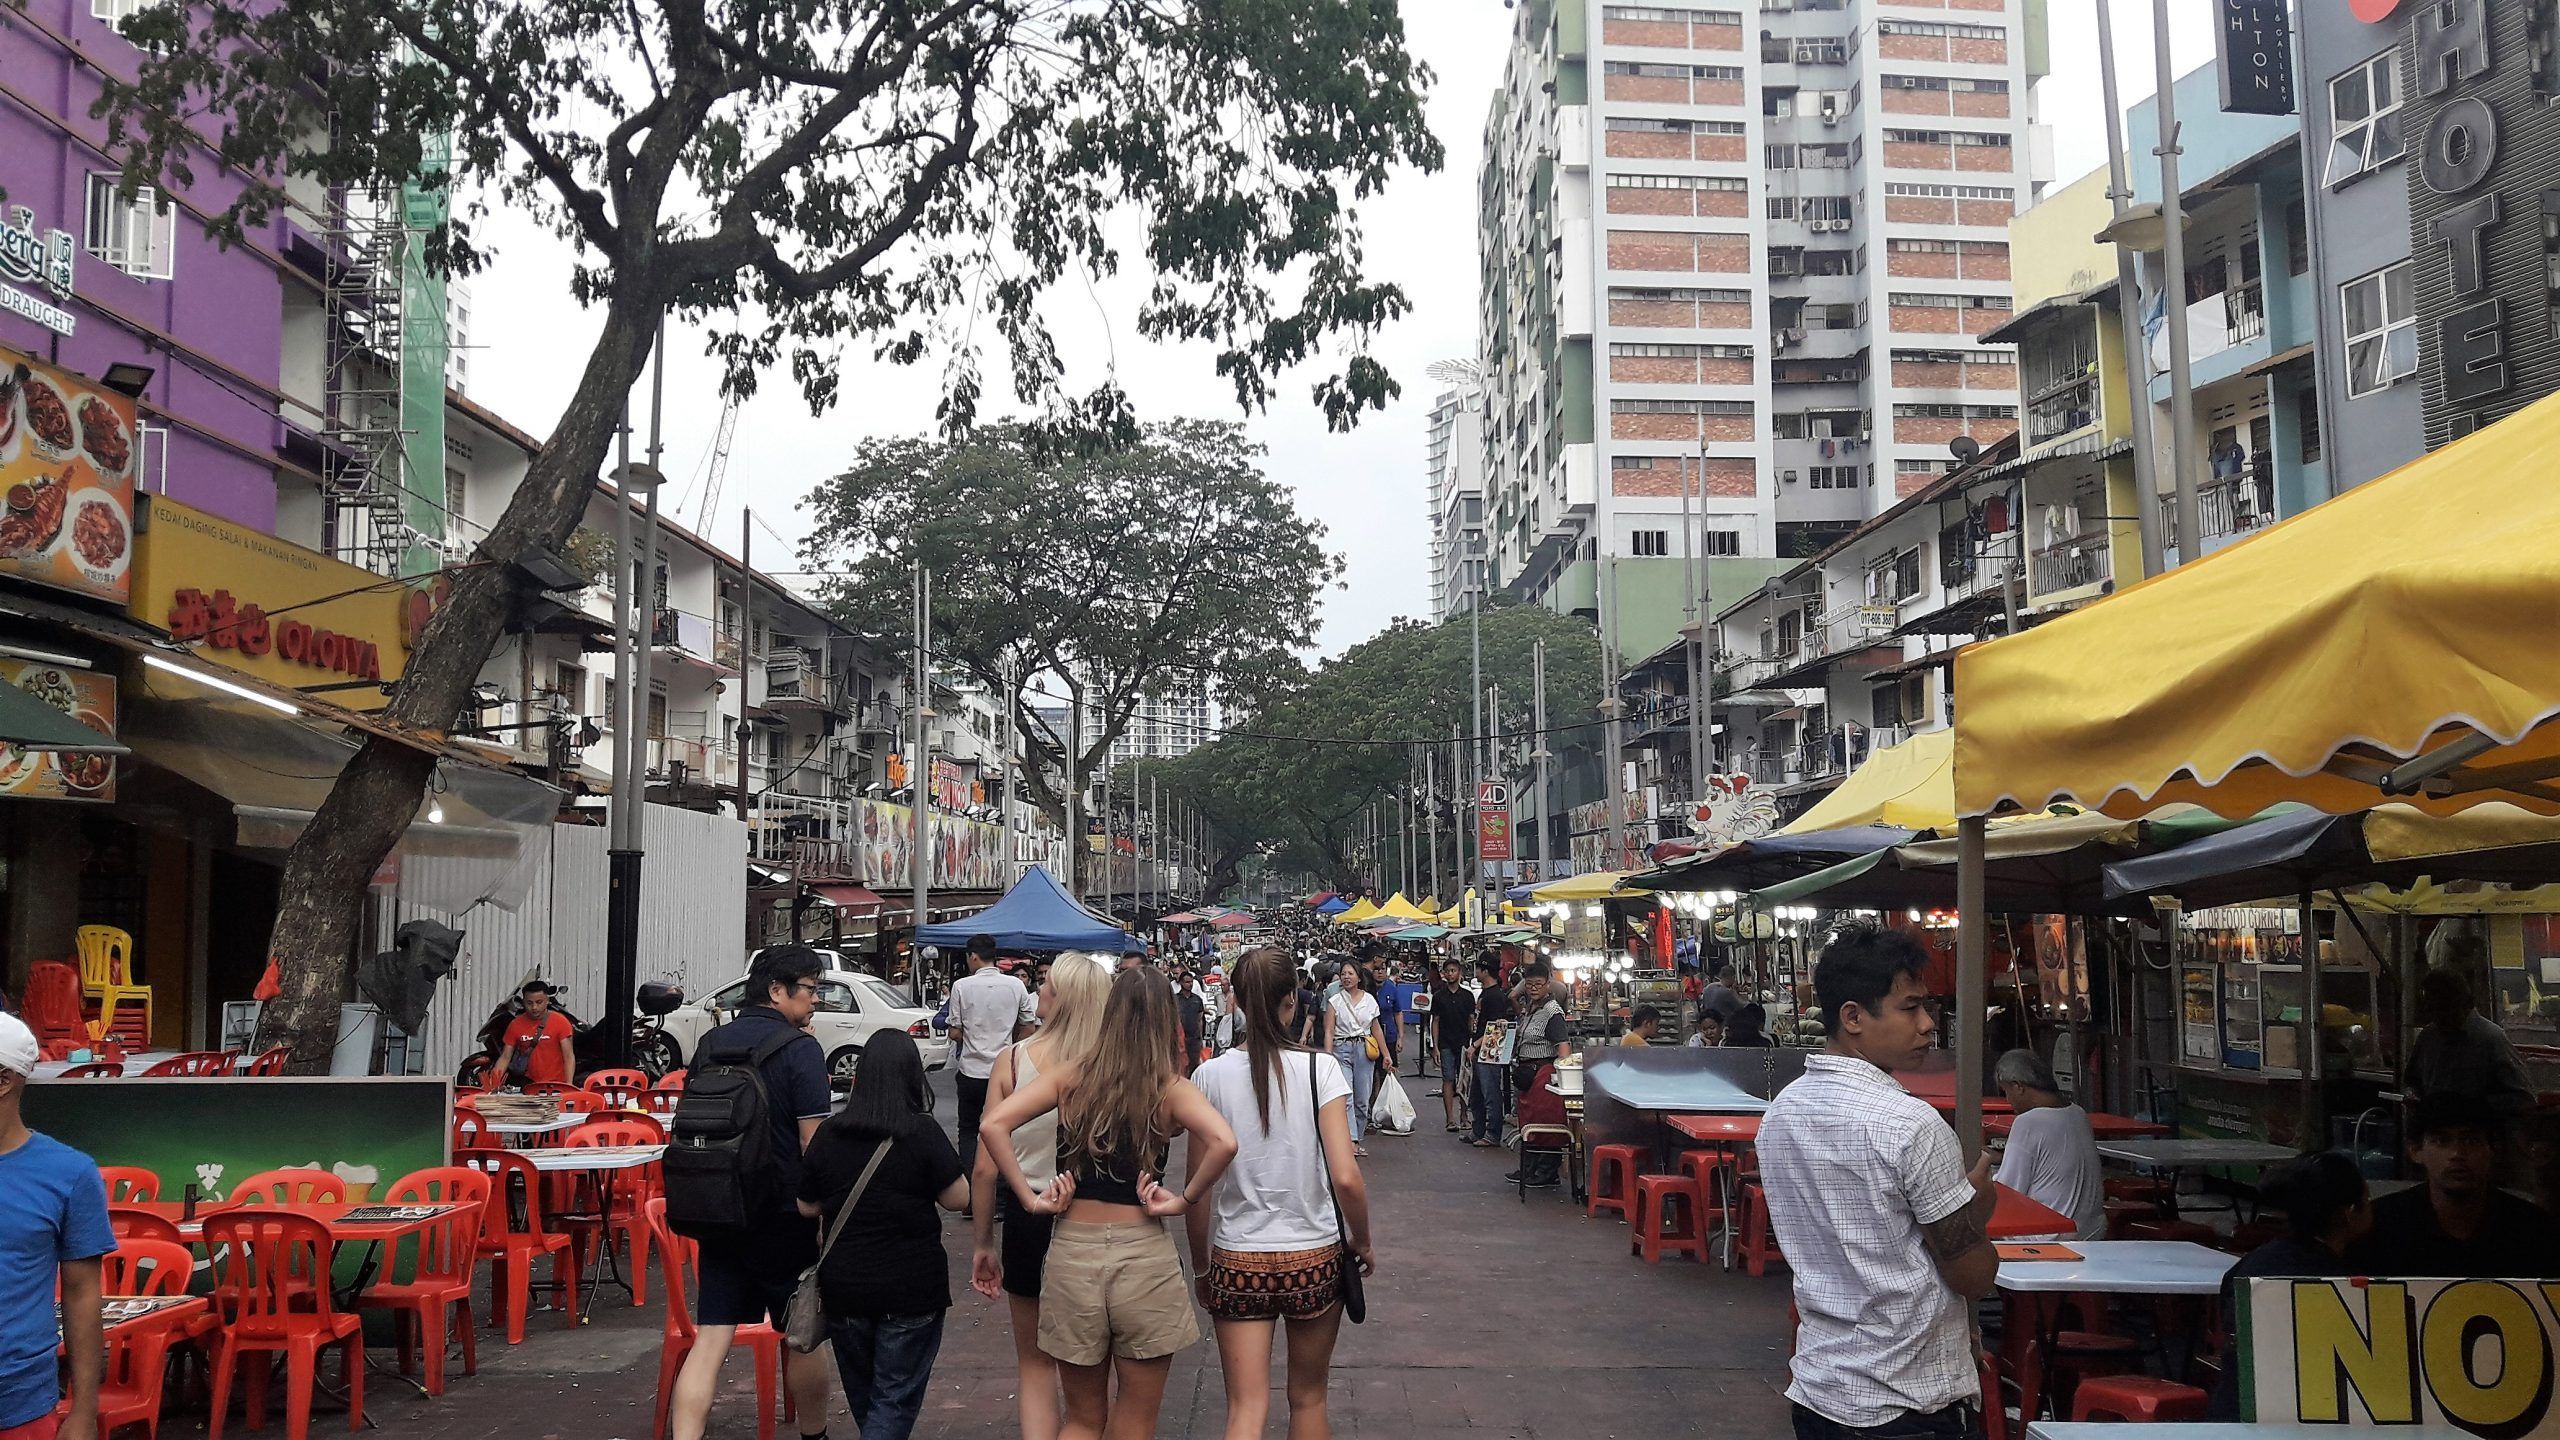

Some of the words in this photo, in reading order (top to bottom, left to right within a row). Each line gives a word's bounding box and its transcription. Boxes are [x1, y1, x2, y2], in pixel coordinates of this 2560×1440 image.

[2275, 28, 2287, 103] GALLERY
[2411, 0, 2506, 442] HOTE
[1, 286, 74, 333] DRAUGHT
[154, 505, 182, 524] KEDAI
[183, 515, 217, 538] DAGING
[251, 539, 290, 564] MAKANAN
[1481, 785, 1507, 804] 4D
[2221, 908, 2246, 929] FOOD
[2291, 1279, 2560, 1440] NO
